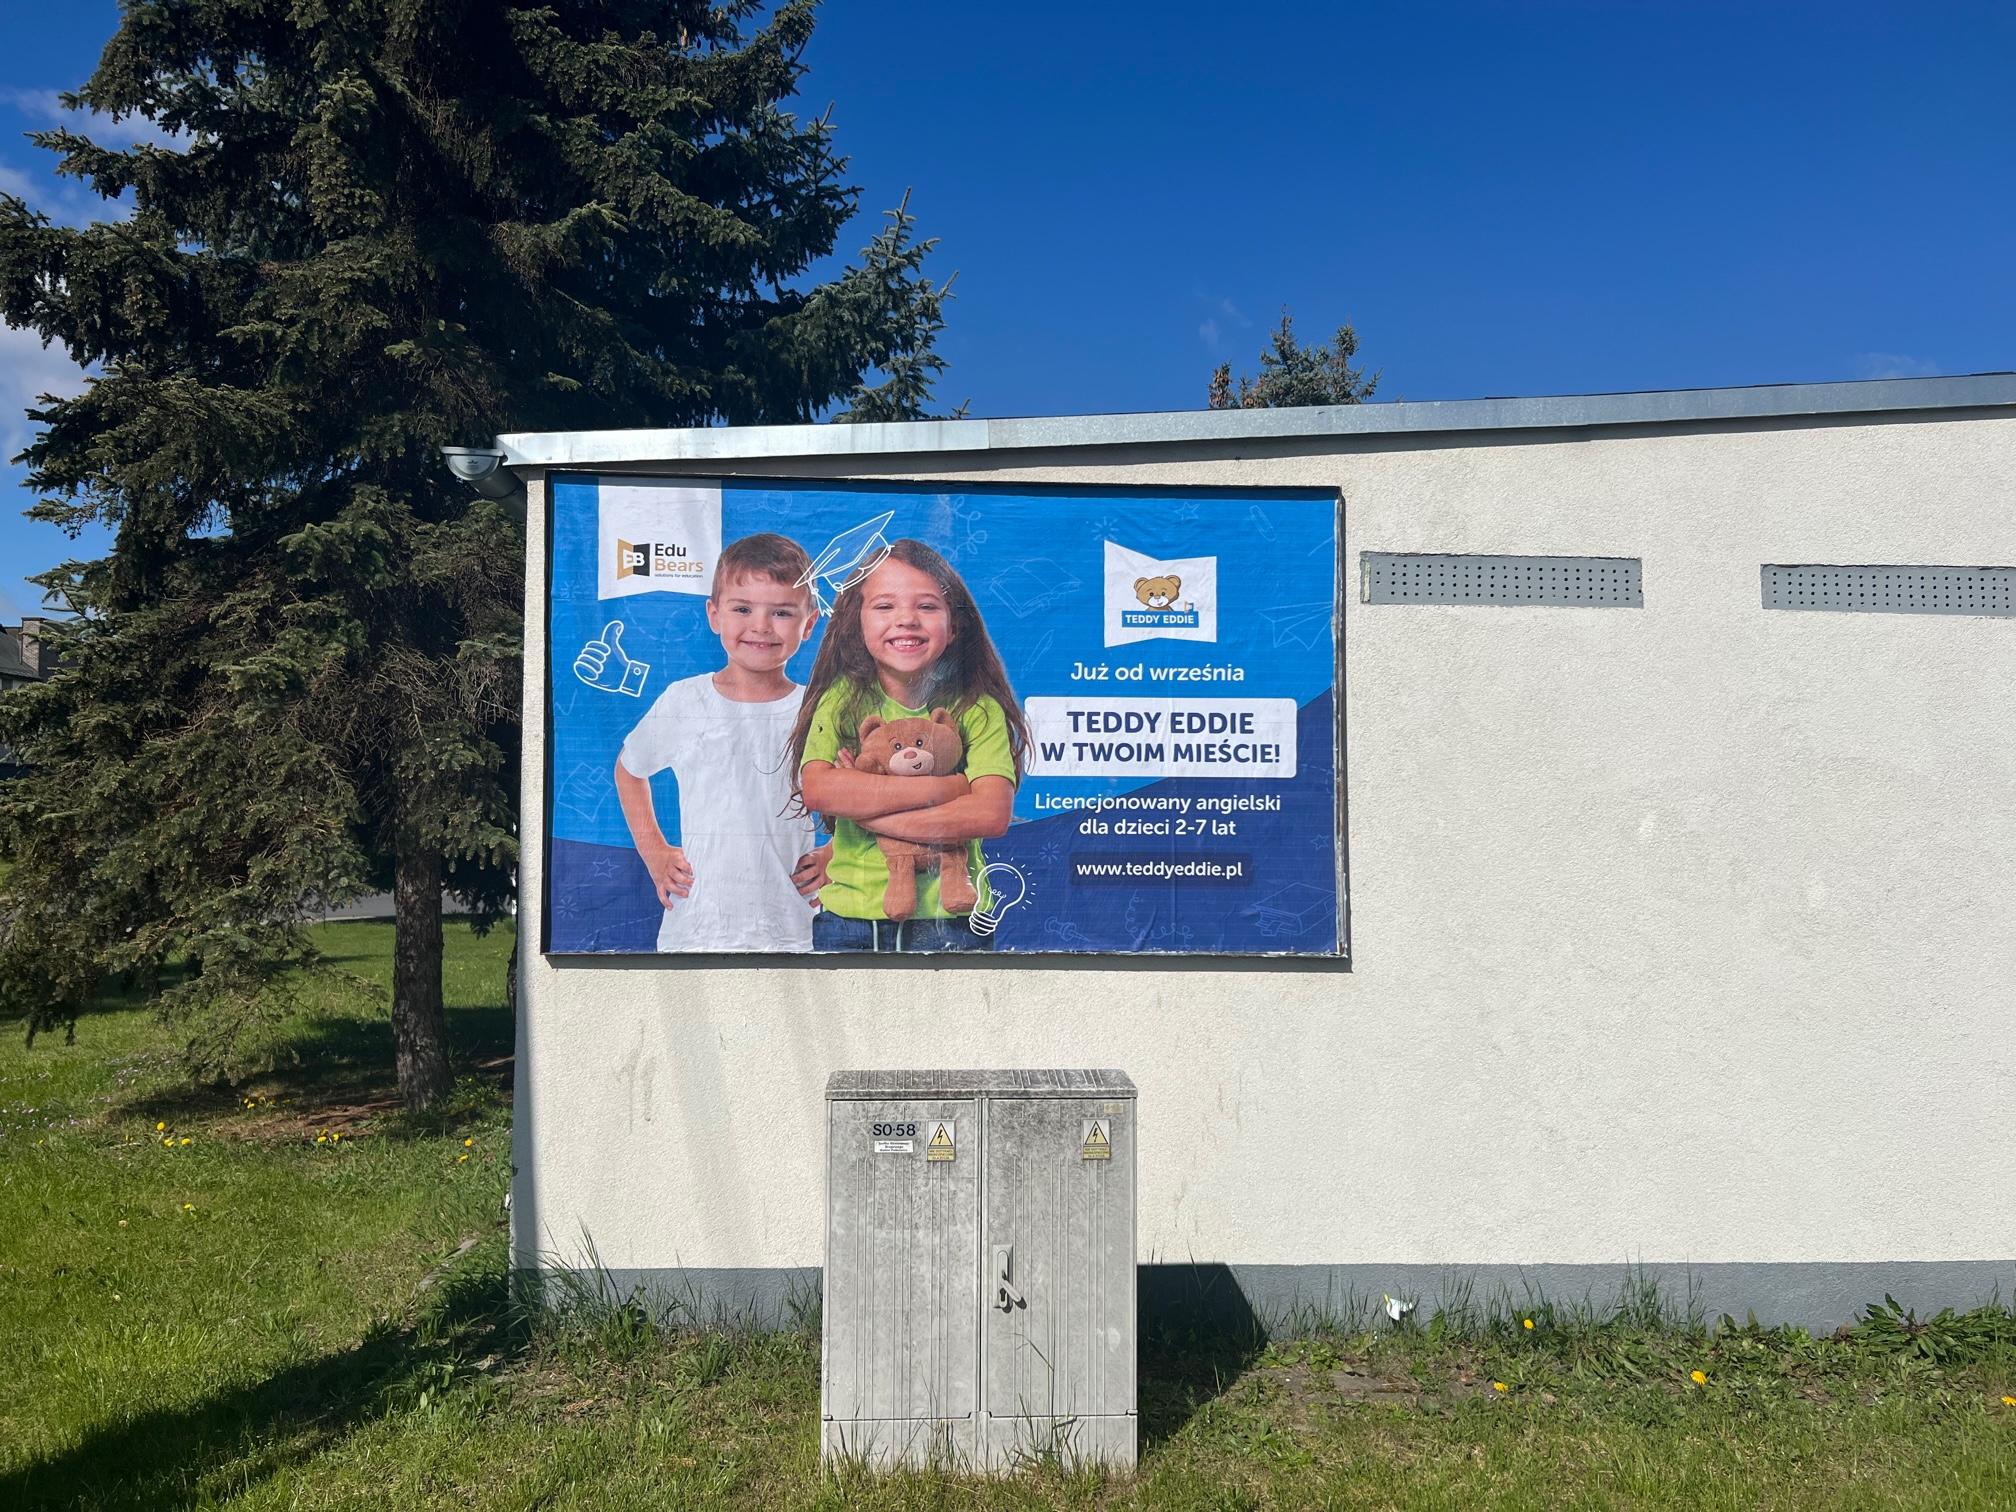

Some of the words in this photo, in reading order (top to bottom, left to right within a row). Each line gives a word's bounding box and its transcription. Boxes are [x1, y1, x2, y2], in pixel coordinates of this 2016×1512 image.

[654, 543, 687, 557] Edu
[654, 558, 704, 572] Bears
[1125, 614, 1160, 624] TEDDY
[1162, 614, 1195, 624] EDDIE
[1070, 662, 1109, 681] Już
[1114, 663, 1143, 681] od
[1150, 663, 1245, 682] września
[1066, 711, 1162, 733] TEDDY
[1170, 712, 1255, 734] EDDIE
[1040, 742, 1066, 762] W
[1072, 742, 1165, 763] TWOIM
[1173, 738, 1281, 763] MIEŚCIE!
[1035, 793, 1191, 814] Licencjonowany
[1196, 794, 1281, 814] angielski
[1079, 819, 1109, 835] dla
[1114, 819, 1170, 835] dzieci
[1175, 819, 1207, 835] 2-7
[1211, 819, 1237, 836] lat
[1076, 861, 1243, 880] www.teddyeddie.pl
